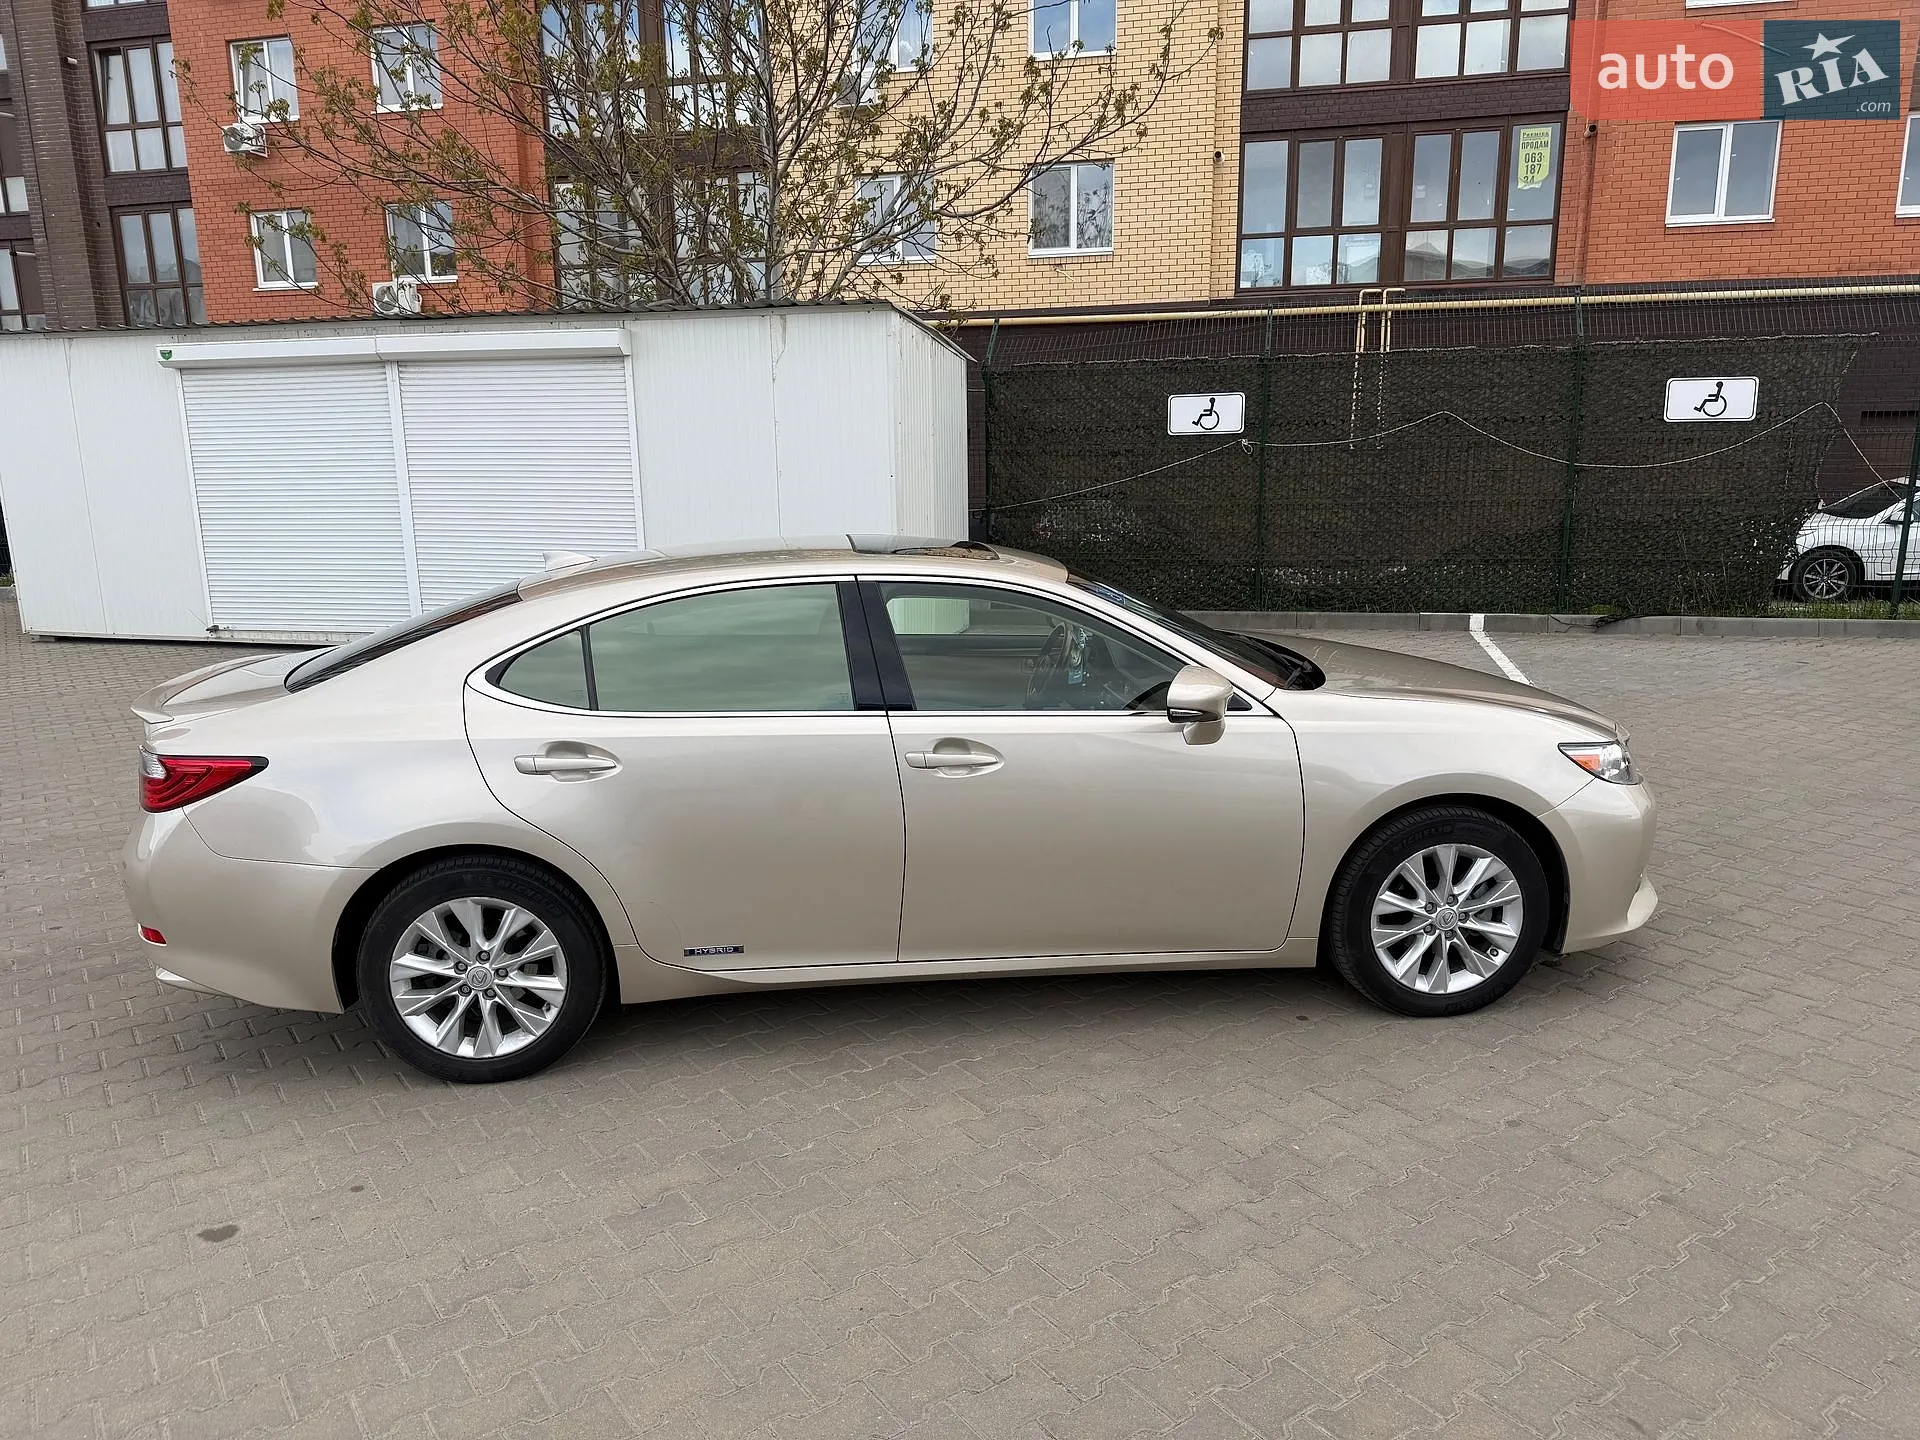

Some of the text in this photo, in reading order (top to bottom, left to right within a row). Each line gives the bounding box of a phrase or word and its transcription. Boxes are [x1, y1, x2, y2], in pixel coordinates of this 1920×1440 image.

[1521, 140, 1549, 150] ПРОДАМ
[1525, 163, 1542, 175] 187
[694, 946, 734, 955] HYBRID
